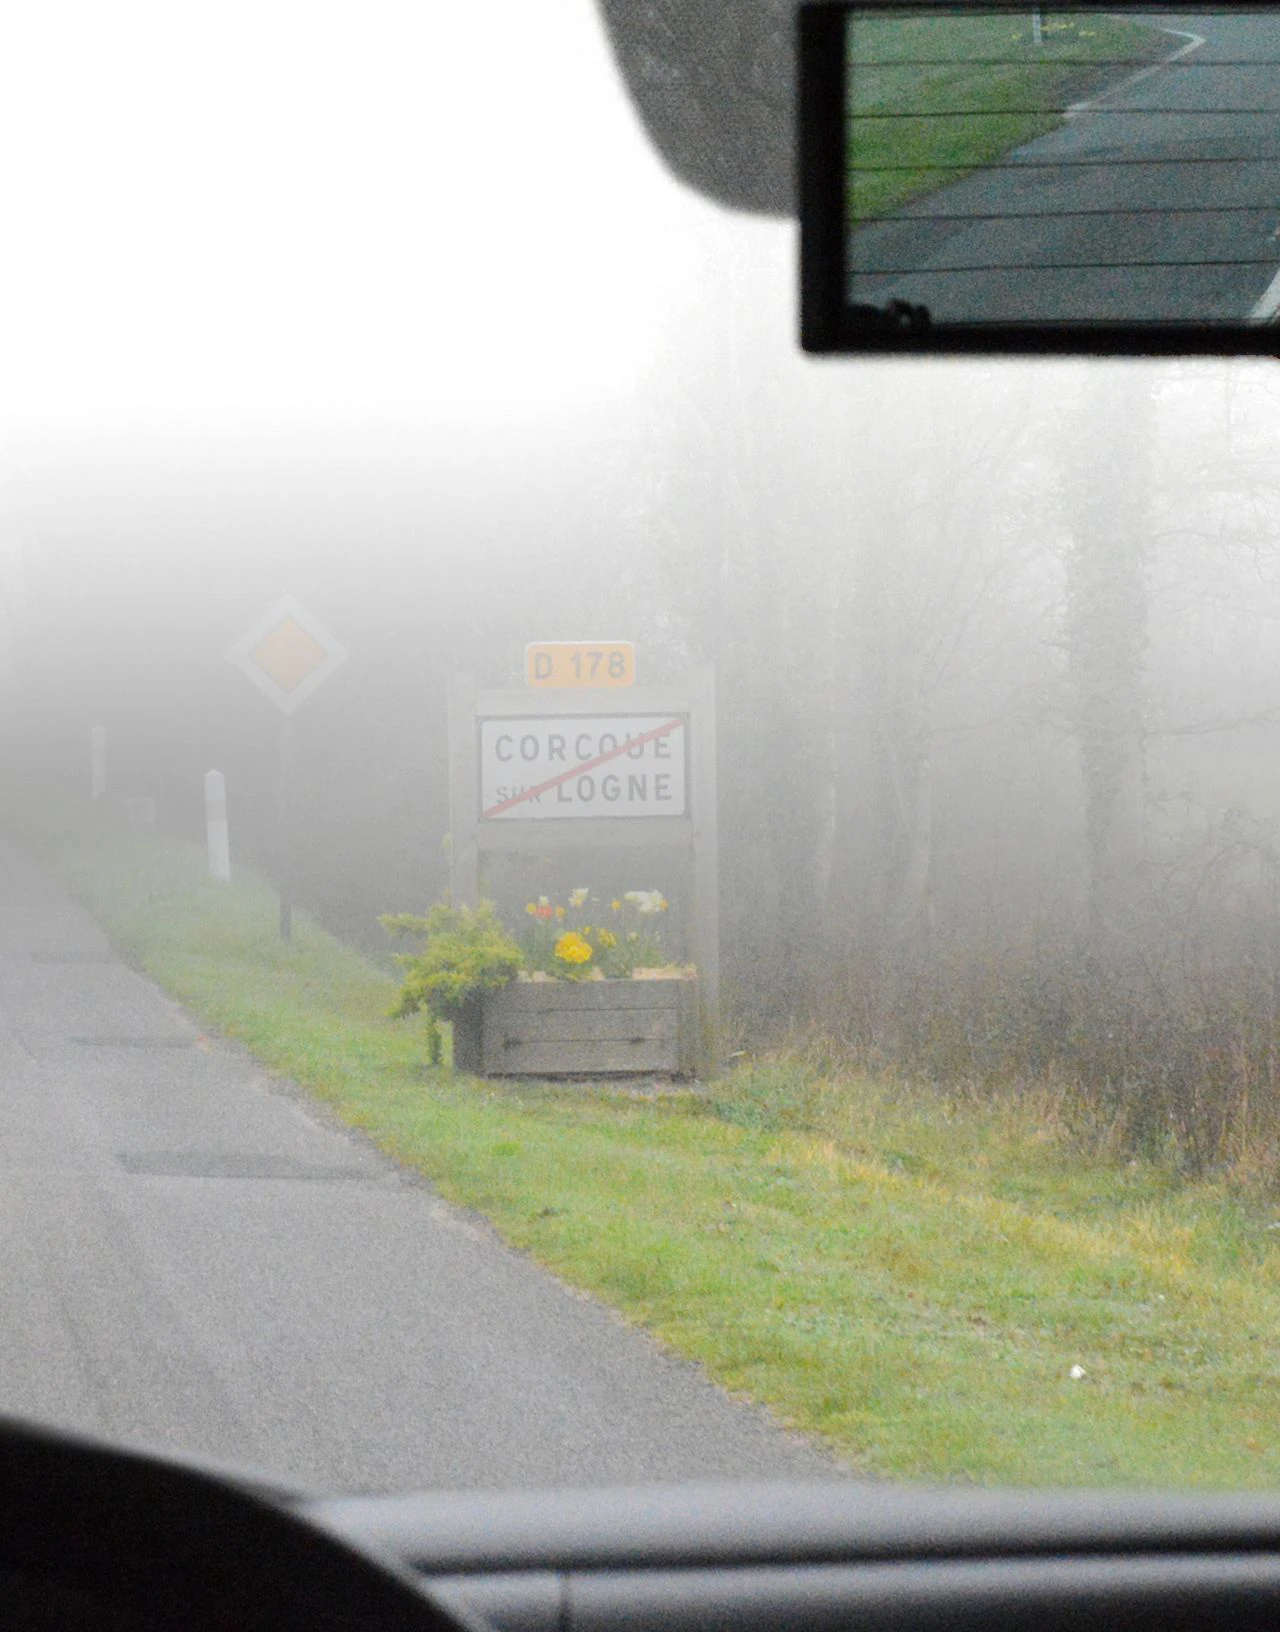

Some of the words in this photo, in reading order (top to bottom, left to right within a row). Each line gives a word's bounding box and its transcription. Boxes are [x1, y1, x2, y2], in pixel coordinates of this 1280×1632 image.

[534, 652, 554, 680] D
[570, 651, 626, 679] 178
[557, 773, 672, 803] LOGNE
